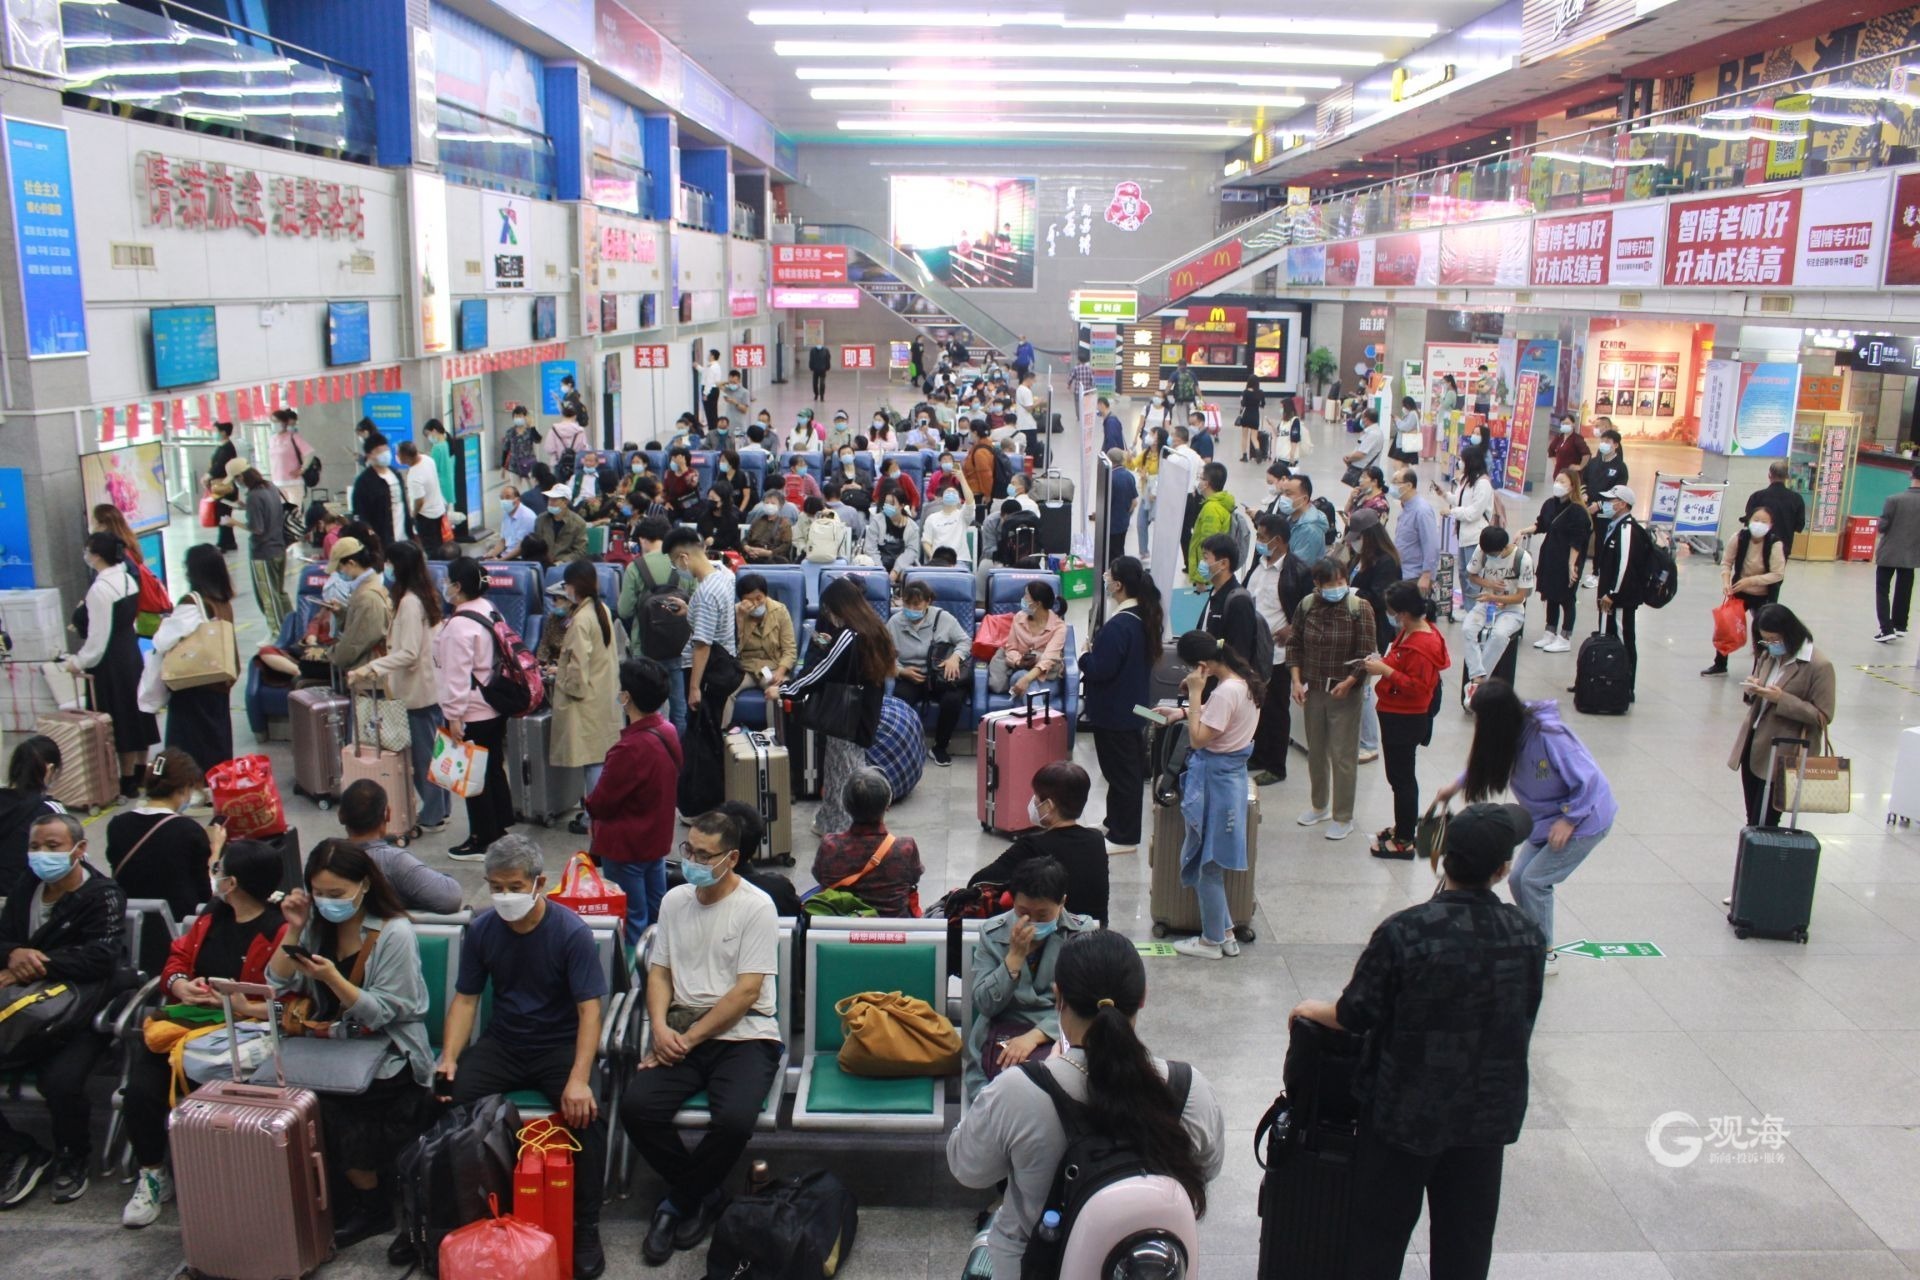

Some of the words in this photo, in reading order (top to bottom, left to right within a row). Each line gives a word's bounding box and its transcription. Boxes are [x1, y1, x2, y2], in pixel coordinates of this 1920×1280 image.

[1677, 201, 1791, 243] 智博老师好
[1536, 220, 1607, 252] 智博老师好
[1809, 226, 1871, 249] 智博专升本
[1617, 240, 1654, 257] 智博专升本
[1534, 255, 1603, 284] 升本成绩高
[1674, 246, 1785, 285] 升本成绩高
[1093, 303, 1122, 313] 便利店
[1359, 317, 1385, 331] 篮球
[735, 348, 763, 366] 诸城
[844, 349, 872, 367] 即墨
